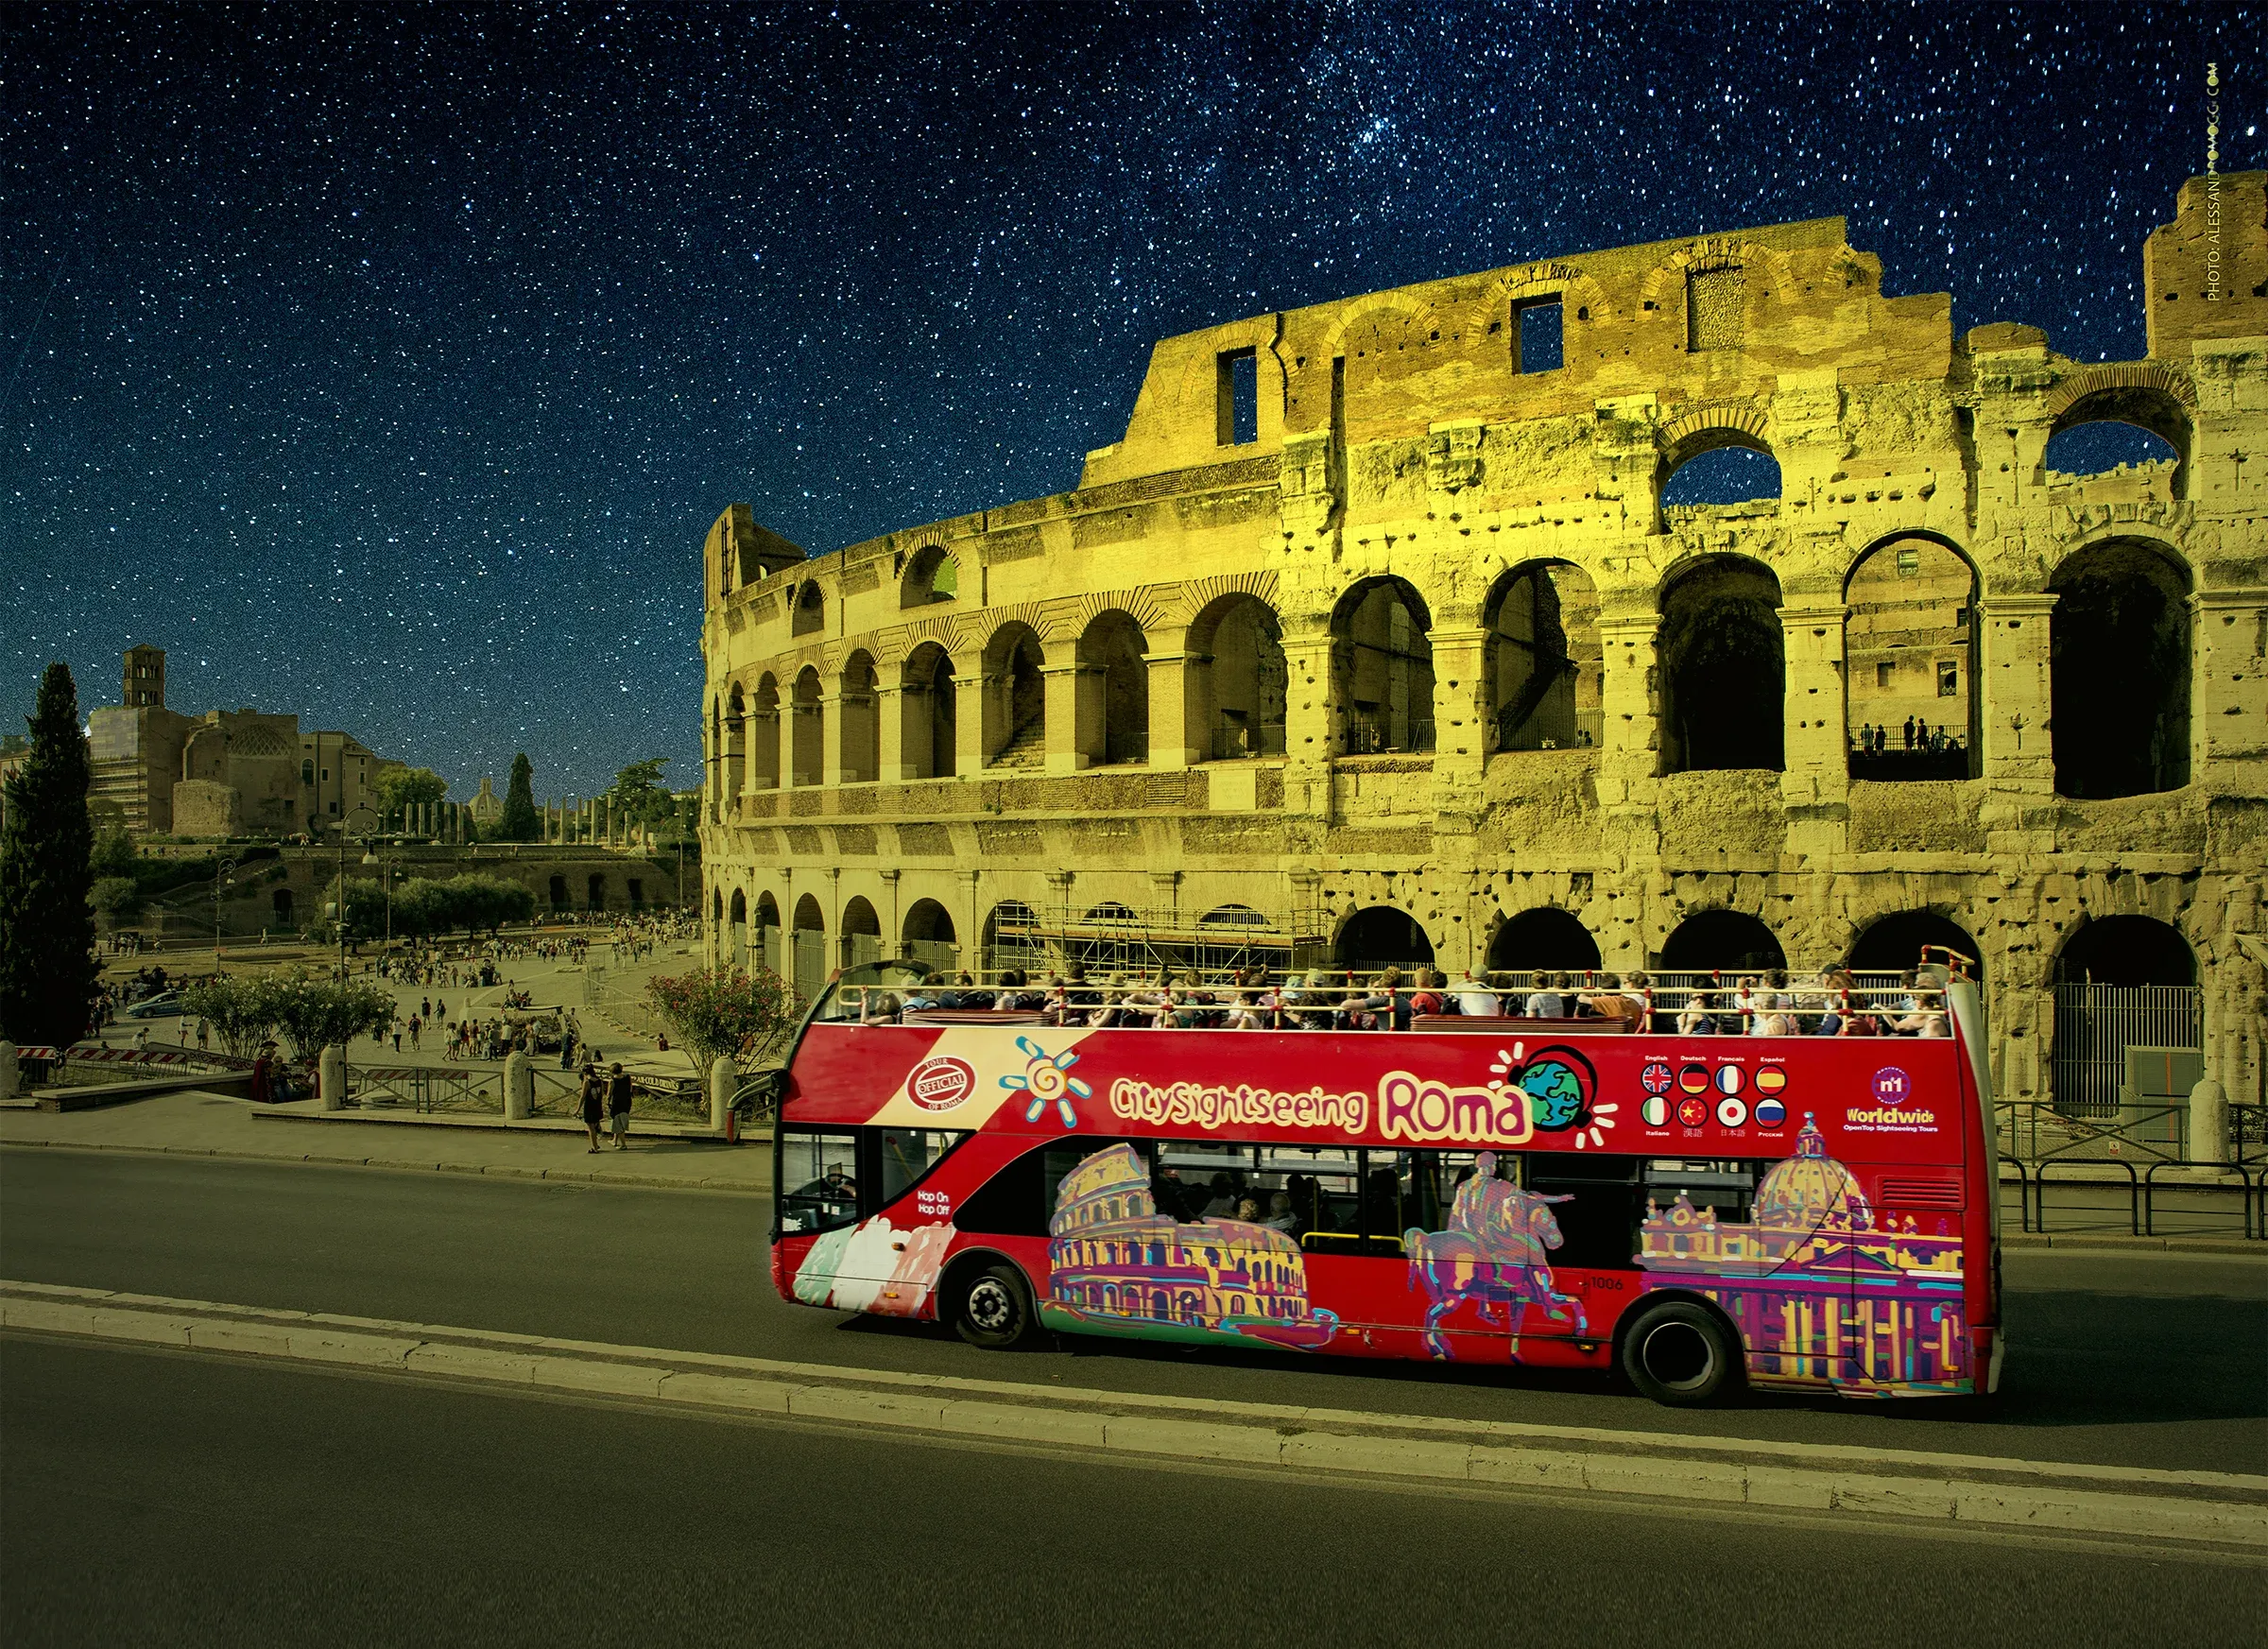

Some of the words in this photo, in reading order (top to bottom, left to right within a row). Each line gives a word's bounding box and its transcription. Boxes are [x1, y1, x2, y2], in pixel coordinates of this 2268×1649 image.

[925, 1057, 948, 1069] TOUR
[919, 1074, 965, 1094] OFFICIAL
[940, 1097, 963, 1110] ROMA
[1111, 1078, 1366, 1132] CitySightseeing
[1381, 1073, 1529, 1142] Roma
[1847, 1108, 1934, 1124] Worldwide
[1721, 1129, 1745, 1138] 日本語
[918, 1191, 936, 1202] Hop
[936, 1192, 949, 1203] On
[918, 1204, 936, 1215] Hop
[936, 1204, 951, 1215] Off
[1591, 1276, 1623, 1291] 1006
